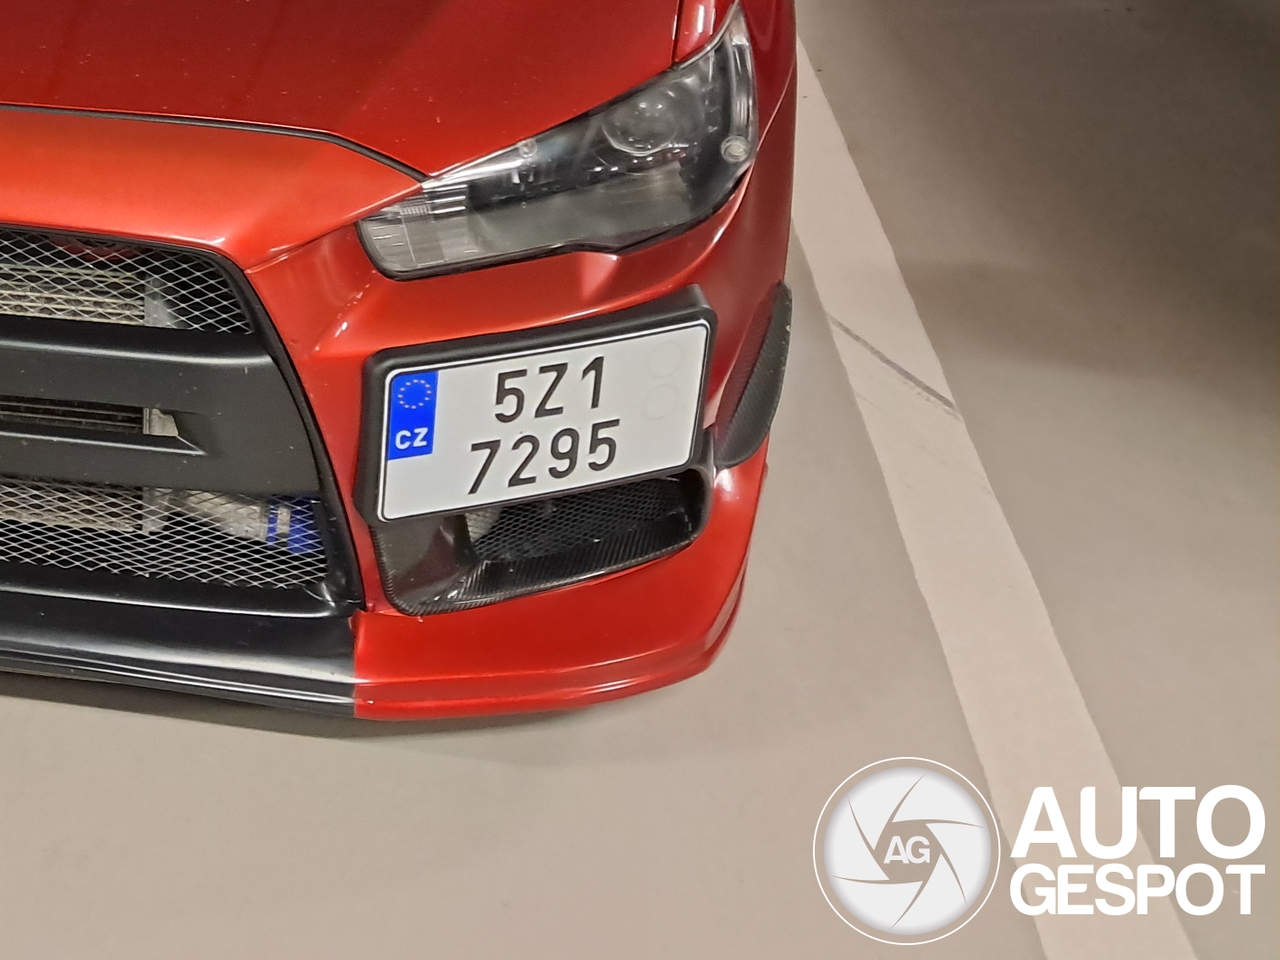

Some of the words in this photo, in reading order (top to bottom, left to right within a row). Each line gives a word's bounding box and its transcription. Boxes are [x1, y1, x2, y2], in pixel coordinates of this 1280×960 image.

[494, 356, 604, 423] 5Z1
[395, 427, 429, 450] CZ
[468, 419, 620, 495] 7295
